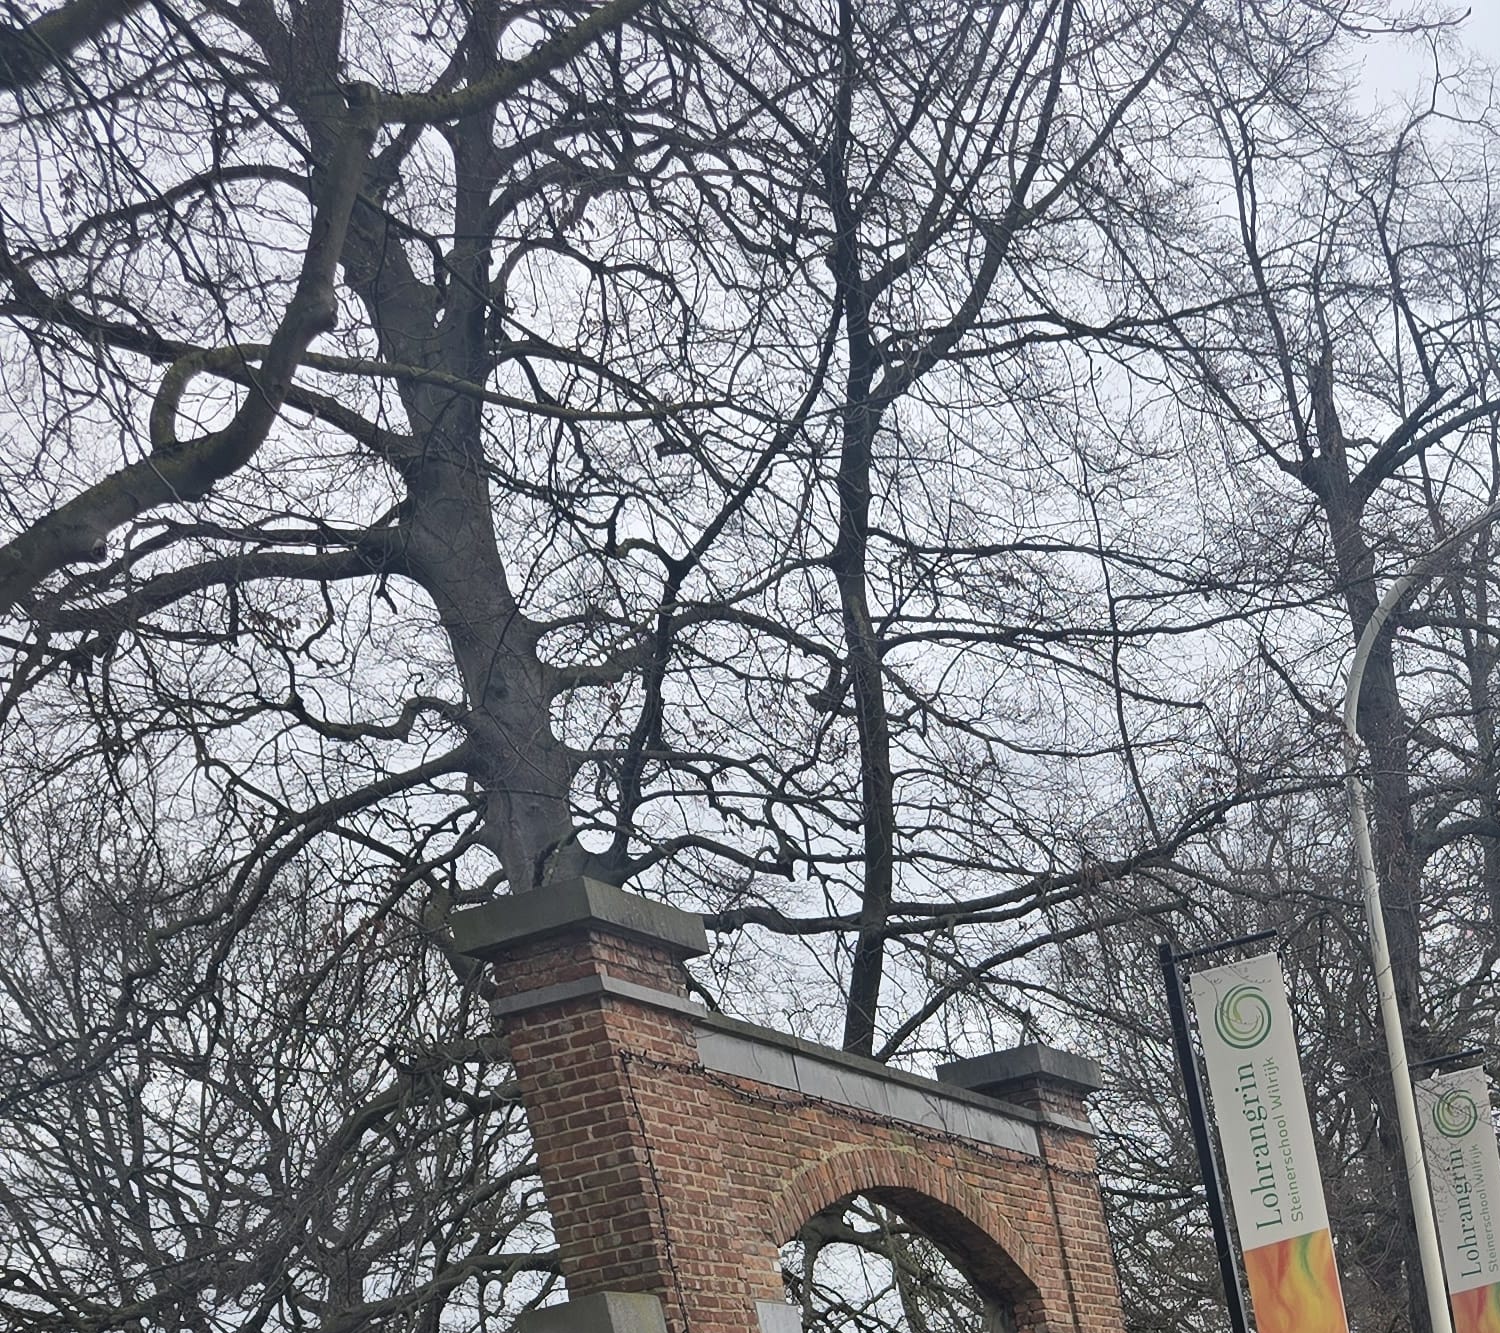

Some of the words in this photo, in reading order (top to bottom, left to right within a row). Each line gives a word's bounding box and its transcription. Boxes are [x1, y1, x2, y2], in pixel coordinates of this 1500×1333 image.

[1262, 1056, 1282, 1111] Wilrijk
[1235, 1062, 1283, 1230] Lohrangrin
[1273, 1115, 1304, 1222] Steinerschool
[1470, 1144, 1485, 1189] Wilrijk
[1446, 1148, 1482, 1278] Lohrangrin
[1476, 1188, 1499, 1273] Steinerschool
